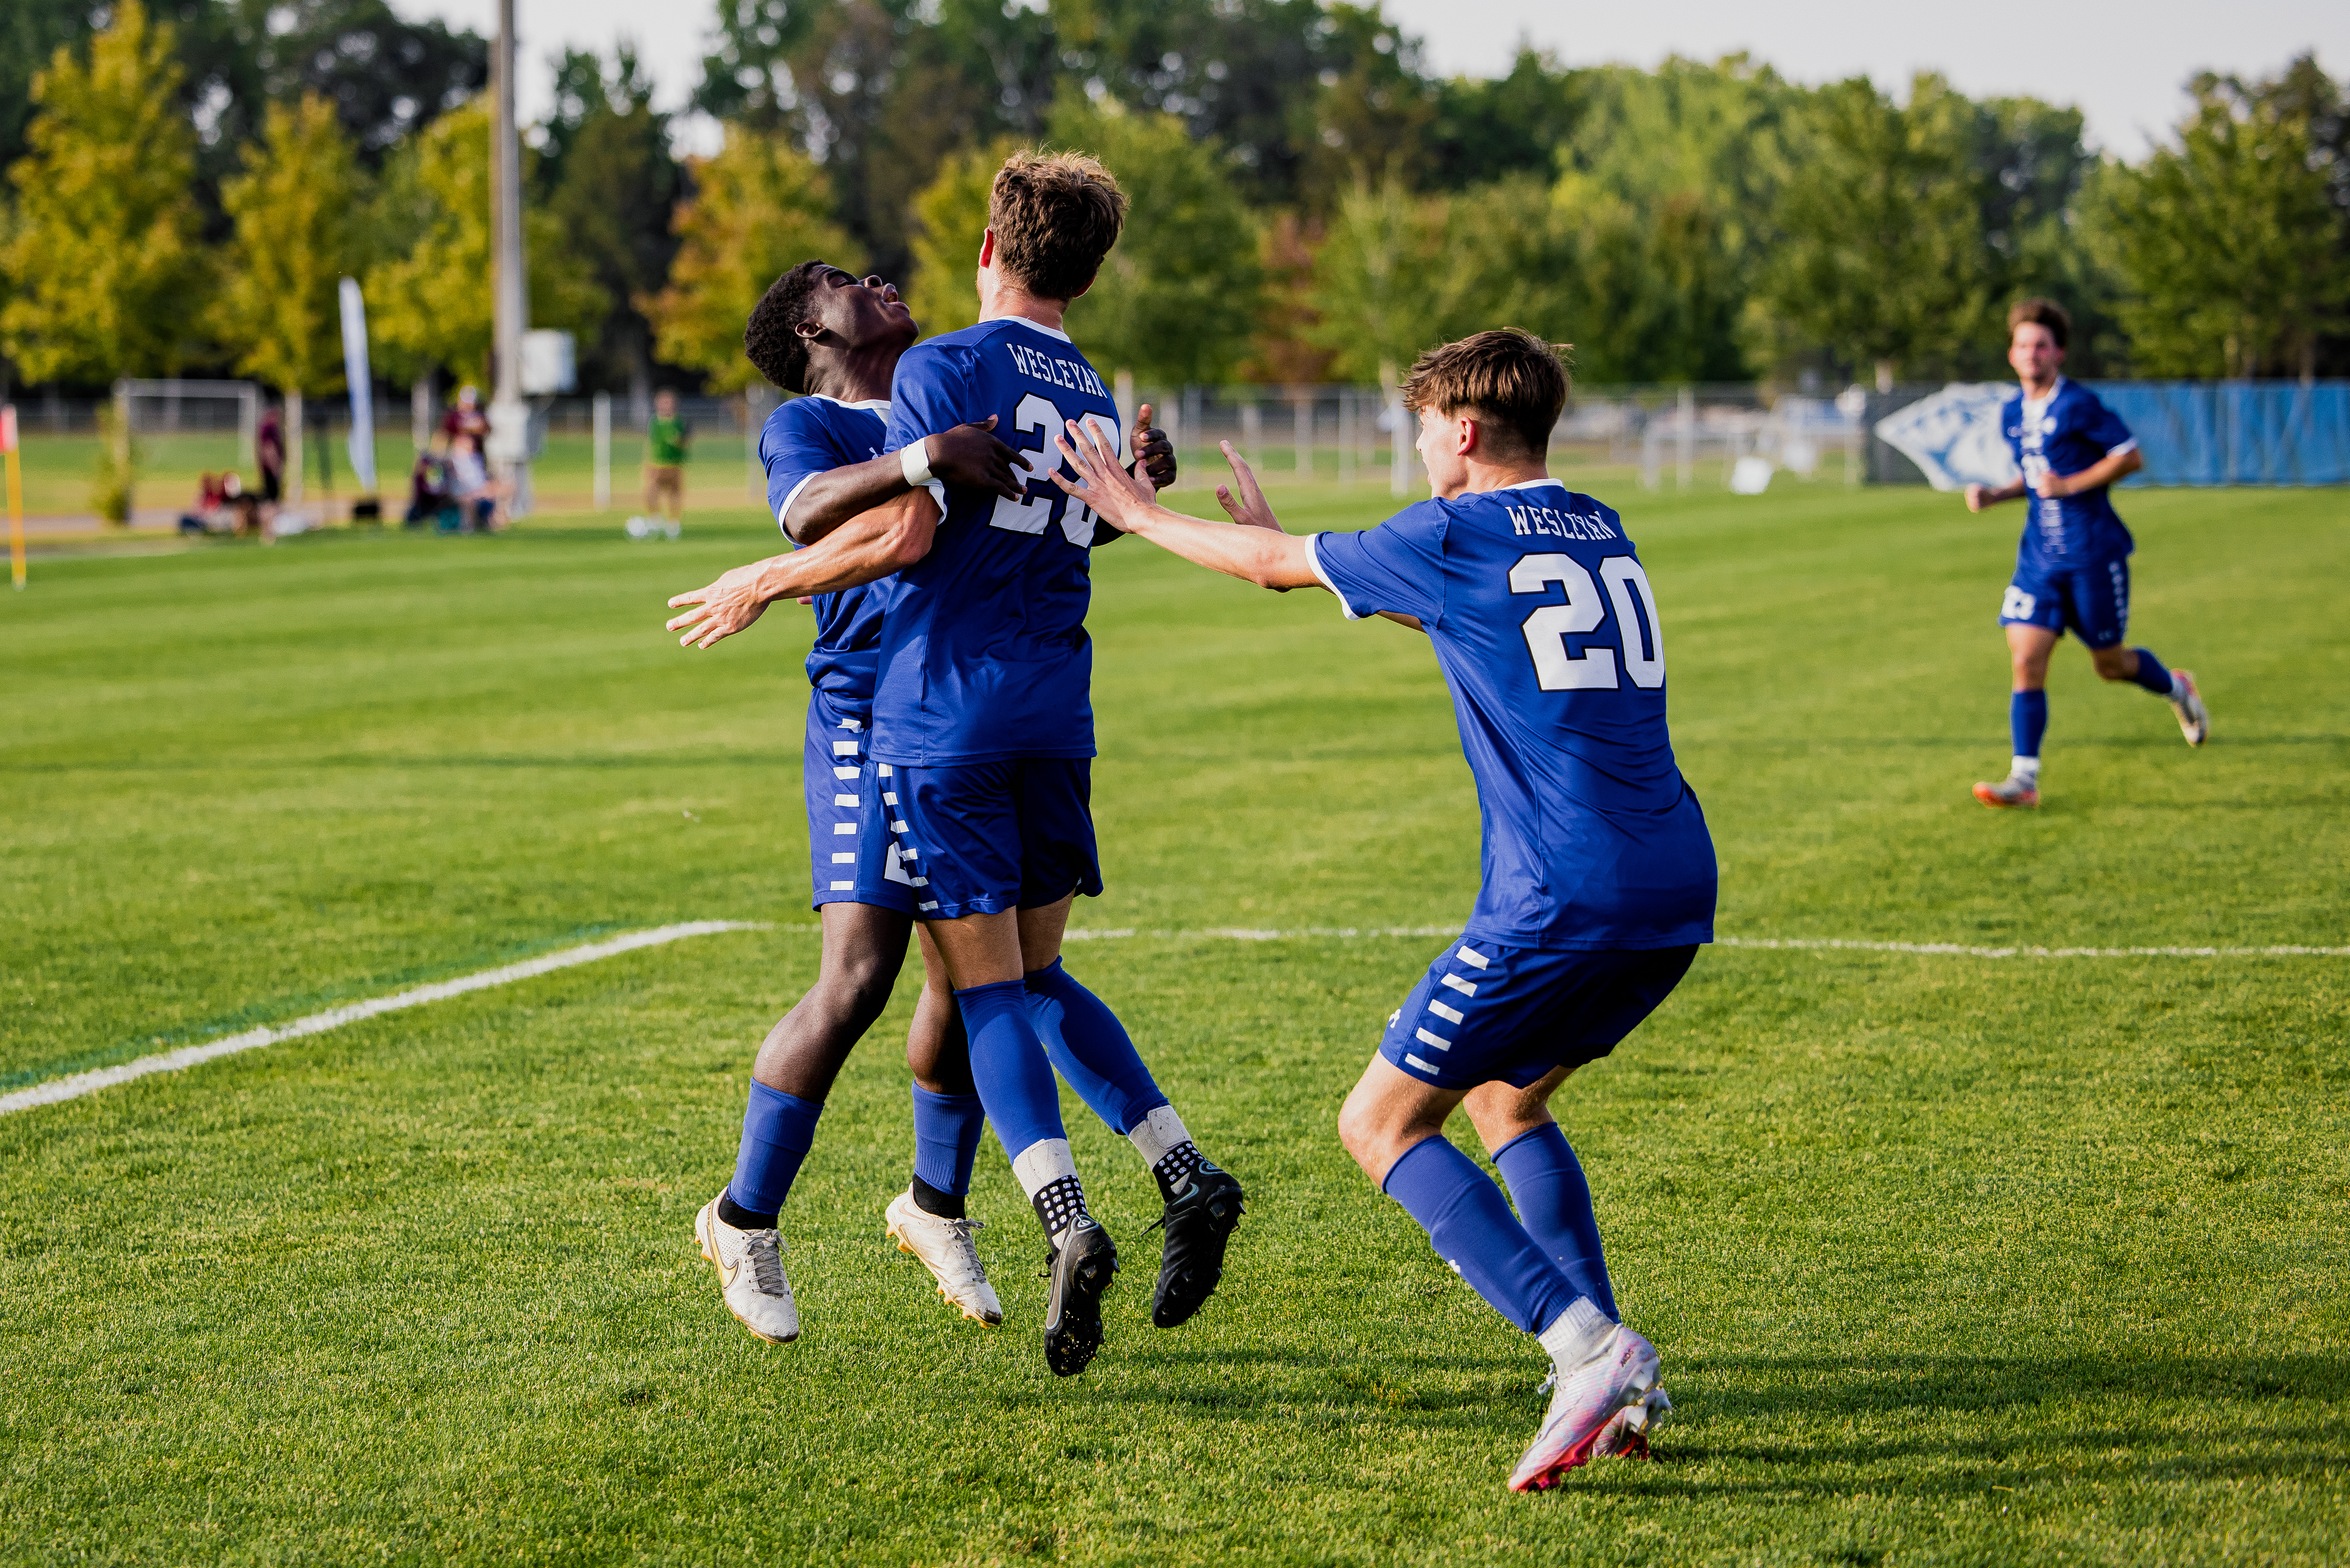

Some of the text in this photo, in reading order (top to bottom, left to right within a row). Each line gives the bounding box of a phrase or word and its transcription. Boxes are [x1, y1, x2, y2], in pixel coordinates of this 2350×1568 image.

[1006, 343, 1108, 399] WESLEYAN
[1505, 505, 1618, 541] WESLEYAN
[1508, 552, 1666, 692] 20
